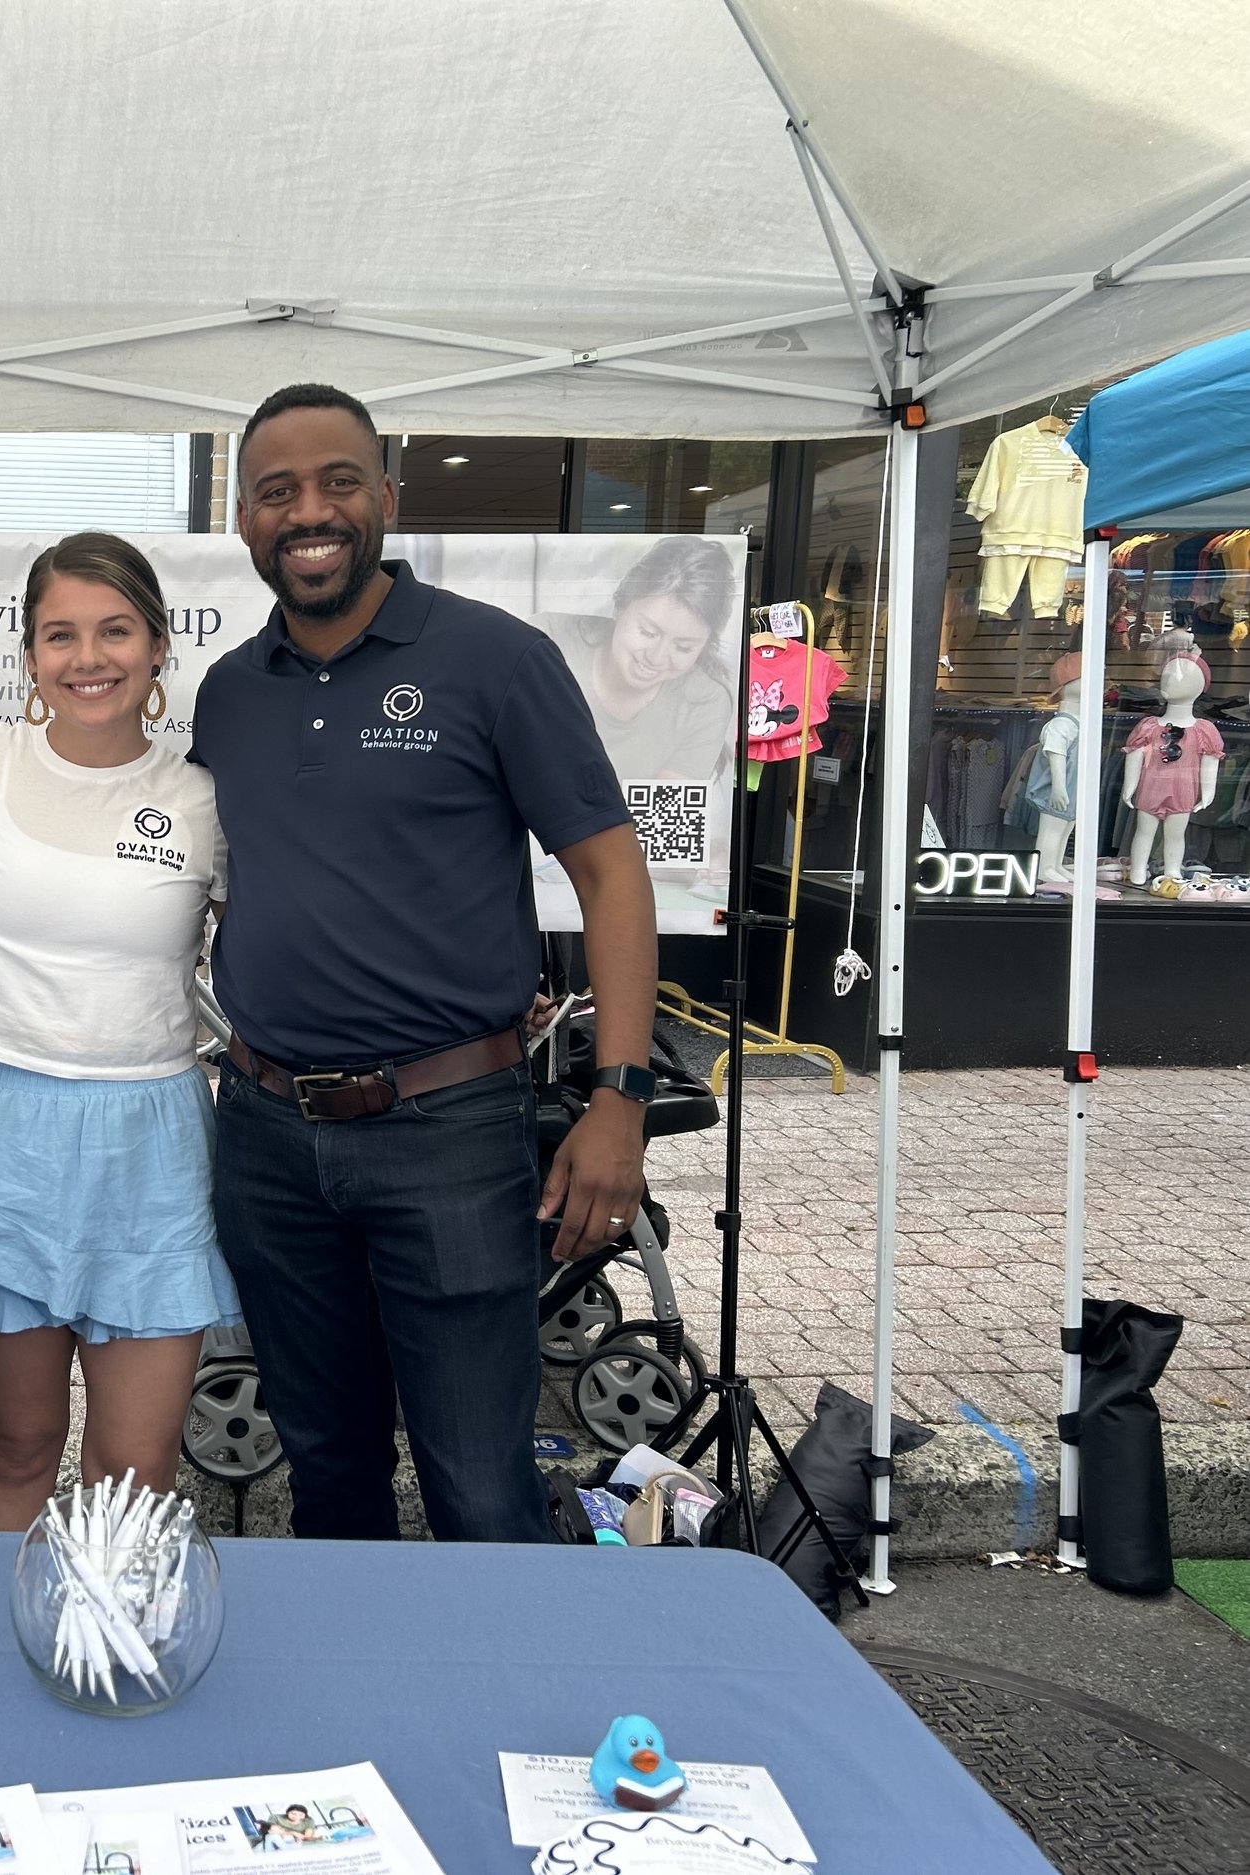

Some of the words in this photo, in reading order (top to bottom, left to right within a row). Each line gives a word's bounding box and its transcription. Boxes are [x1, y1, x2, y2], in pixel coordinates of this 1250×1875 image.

[360, 727, 438, 742] OVATION
[362, 740, 403, 750] behavior
[404, 742, 433, 753] group
[116, 841, 185, 863] OVATION
[117, 852, 156, 863] Behavior
[159, 858, 183, 872] Group
